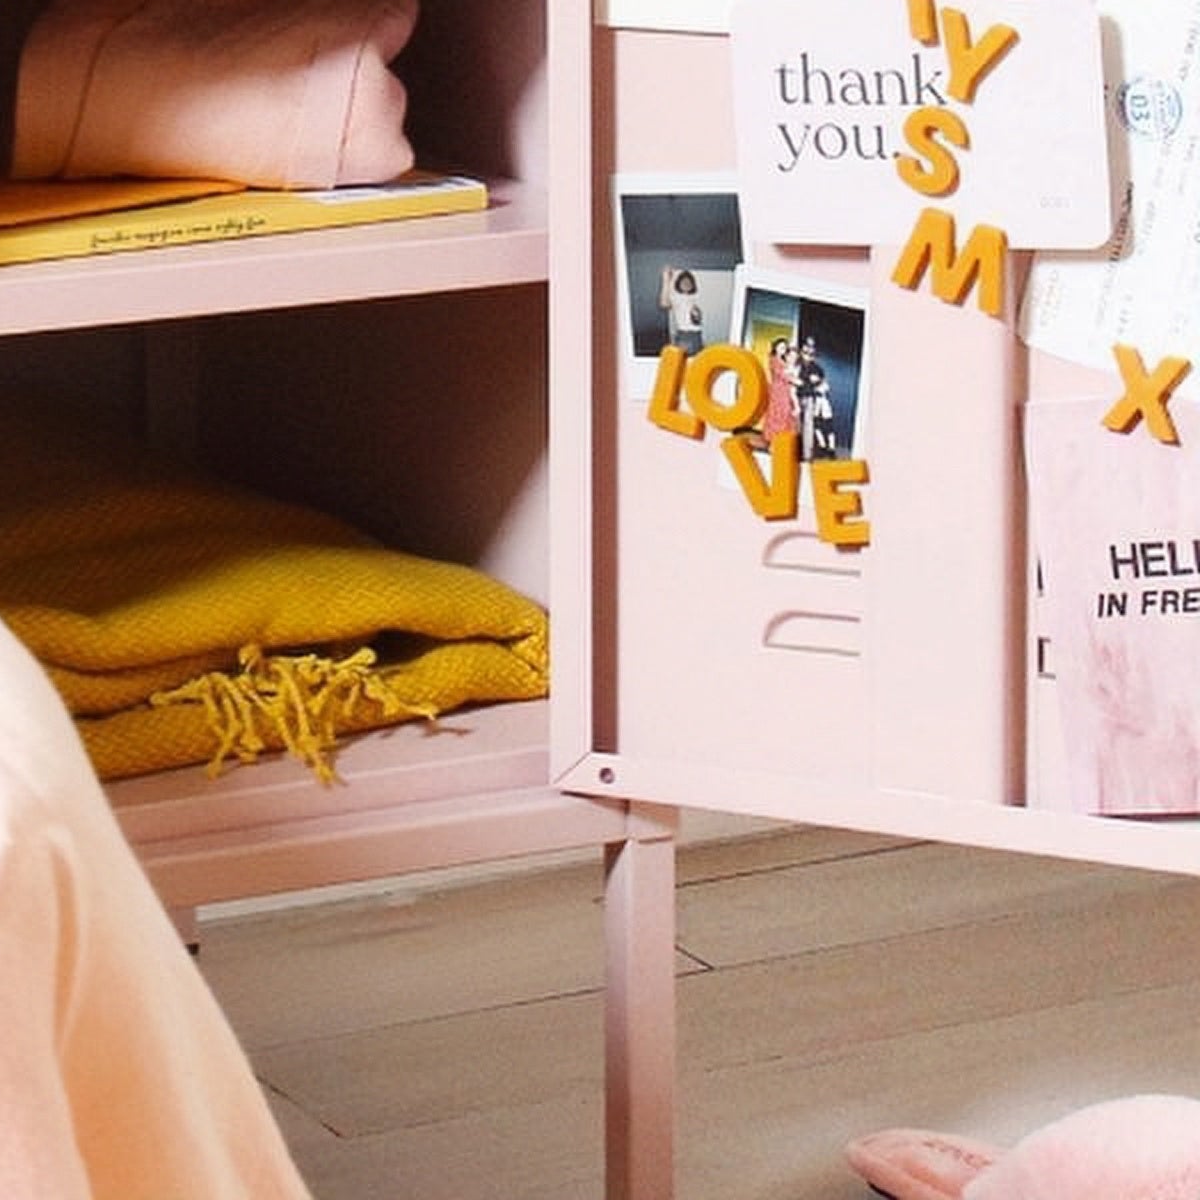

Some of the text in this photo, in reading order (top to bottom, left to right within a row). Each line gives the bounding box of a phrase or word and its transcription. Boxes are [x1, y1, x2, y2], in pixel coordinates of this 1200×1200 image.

[775, 52, 947, 105] thank
[777, 122, 901, 173] you.
[1100, 341, 1192, 448] X
[1097, 591, 1128, 619] IN
